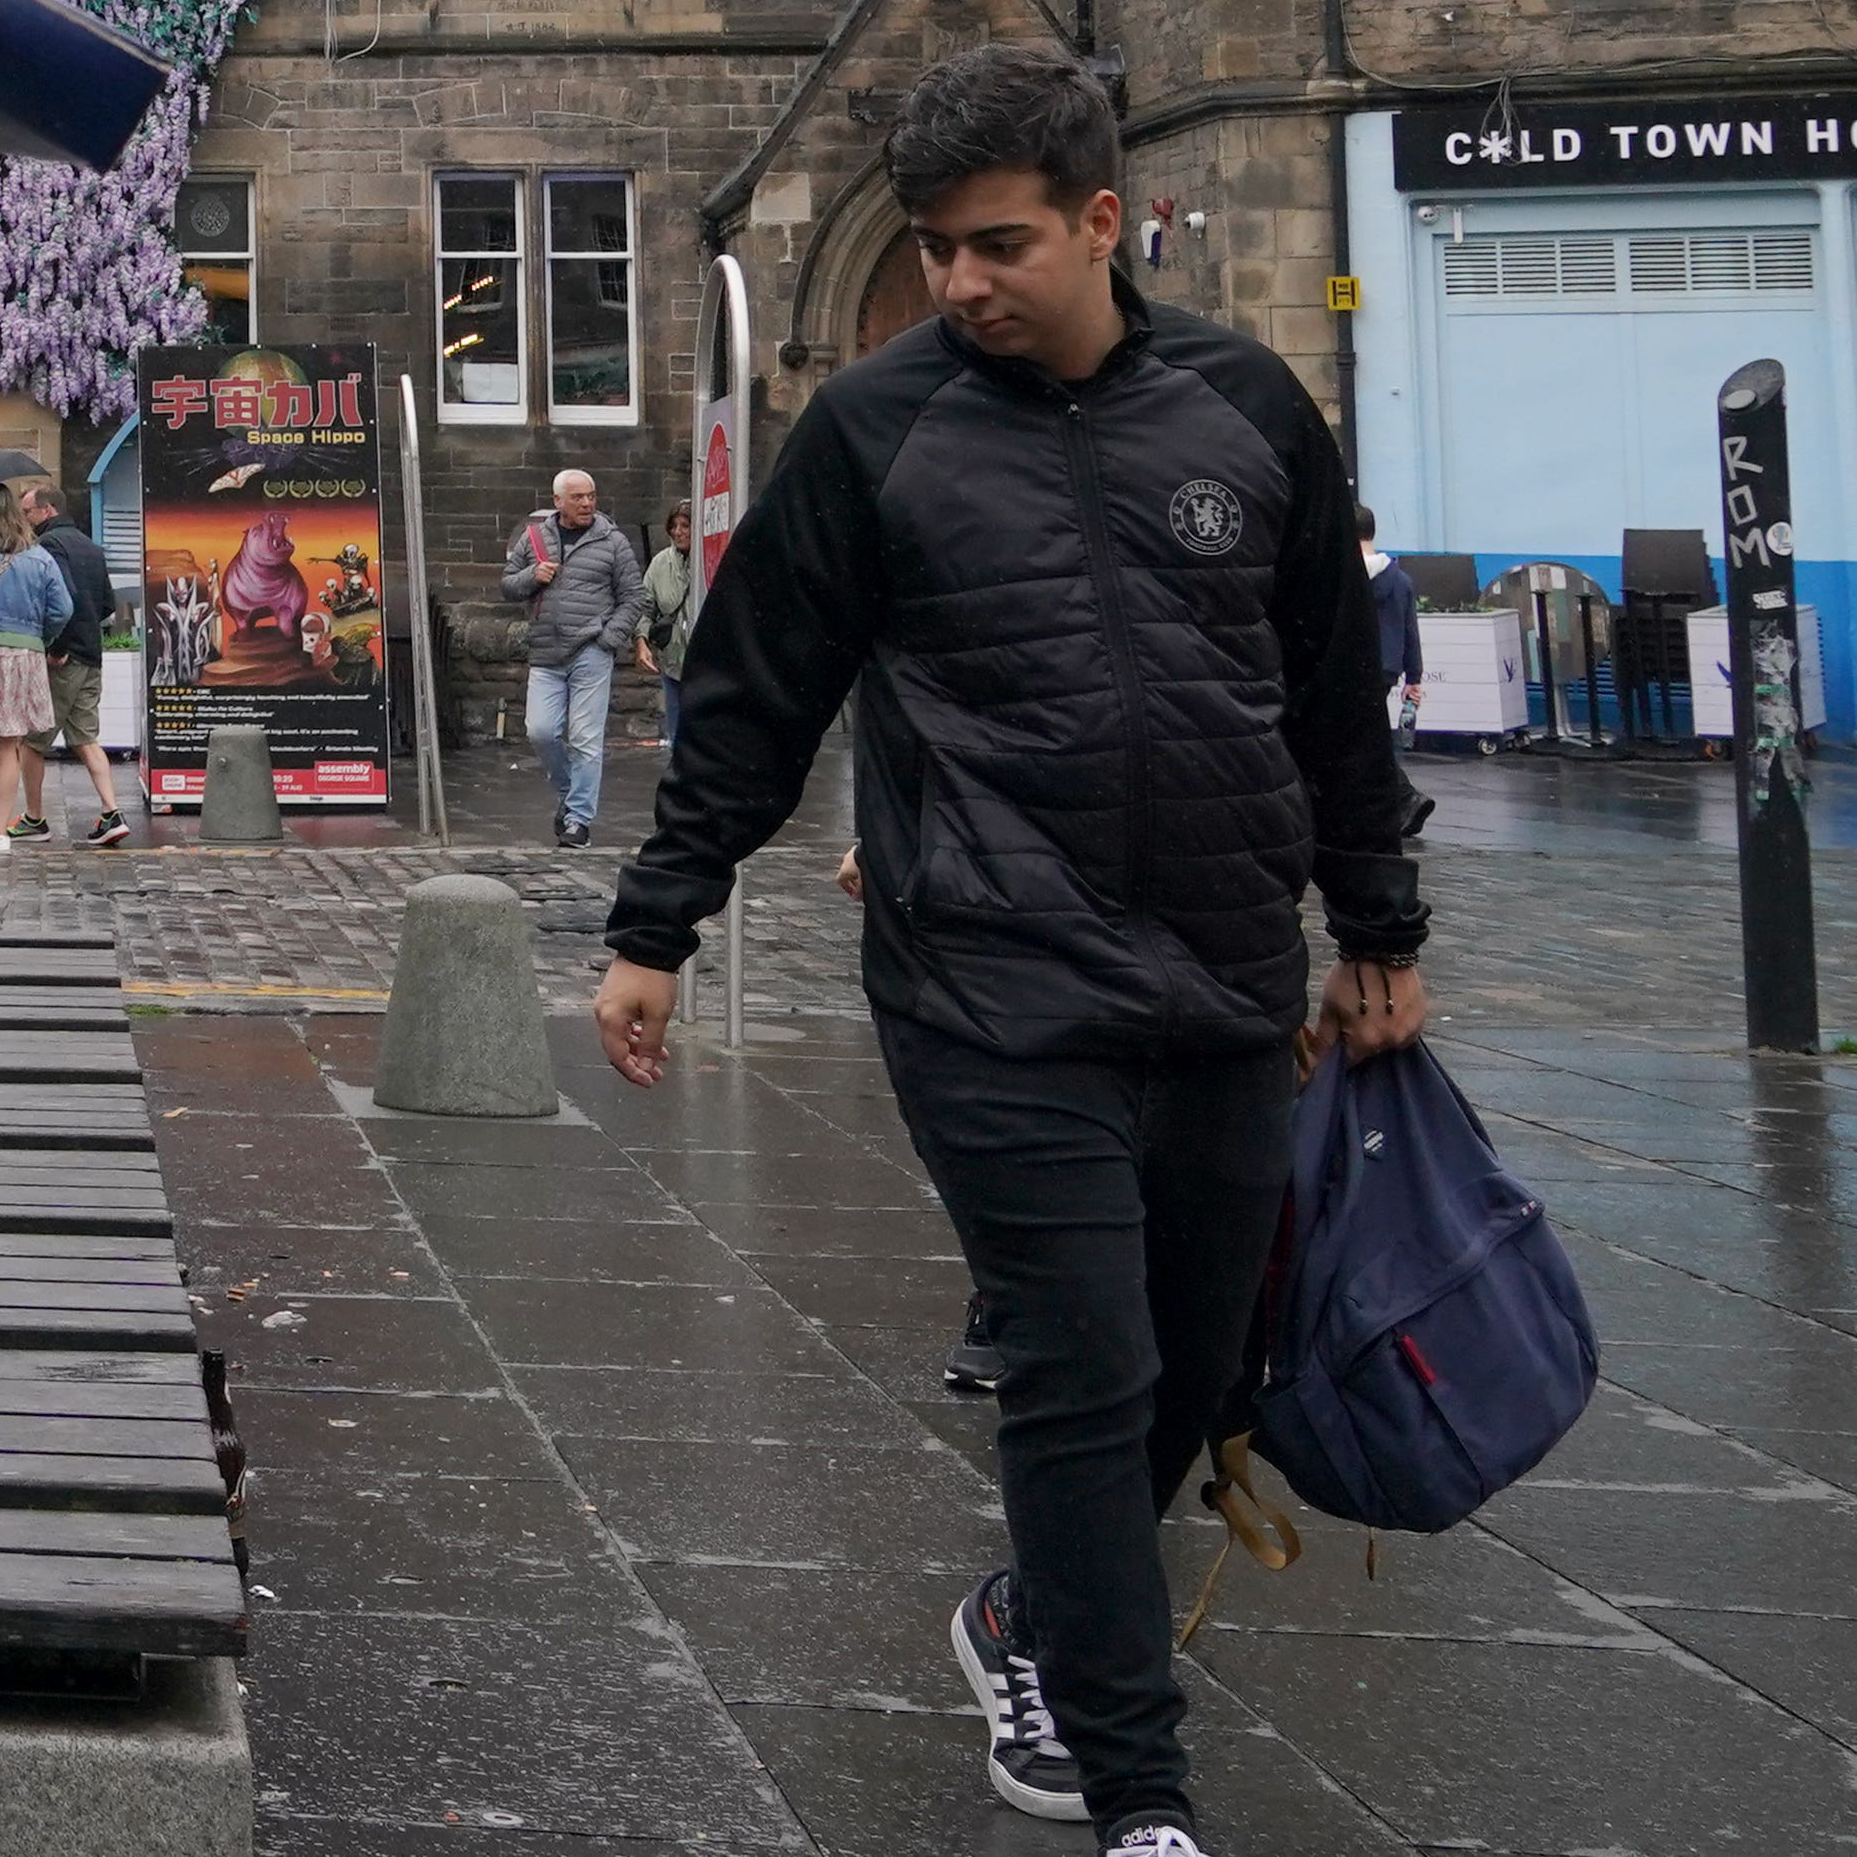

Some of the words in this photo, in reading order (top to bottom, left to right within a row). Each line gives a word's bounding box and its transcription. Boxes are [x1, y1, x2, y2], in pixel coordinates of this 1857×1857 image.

[1609, 120, 1774, 160] TOWN
[1805, 117, 1857, 153] H
[151, 373, 364, 430] 宇宙カバ
[246, 431, 305, 445] Space
[311, 430, 366, 444] Hippo
[1179, 483, 1227, 499] CHELSEA
[318, 764, 370, 775] assembly
